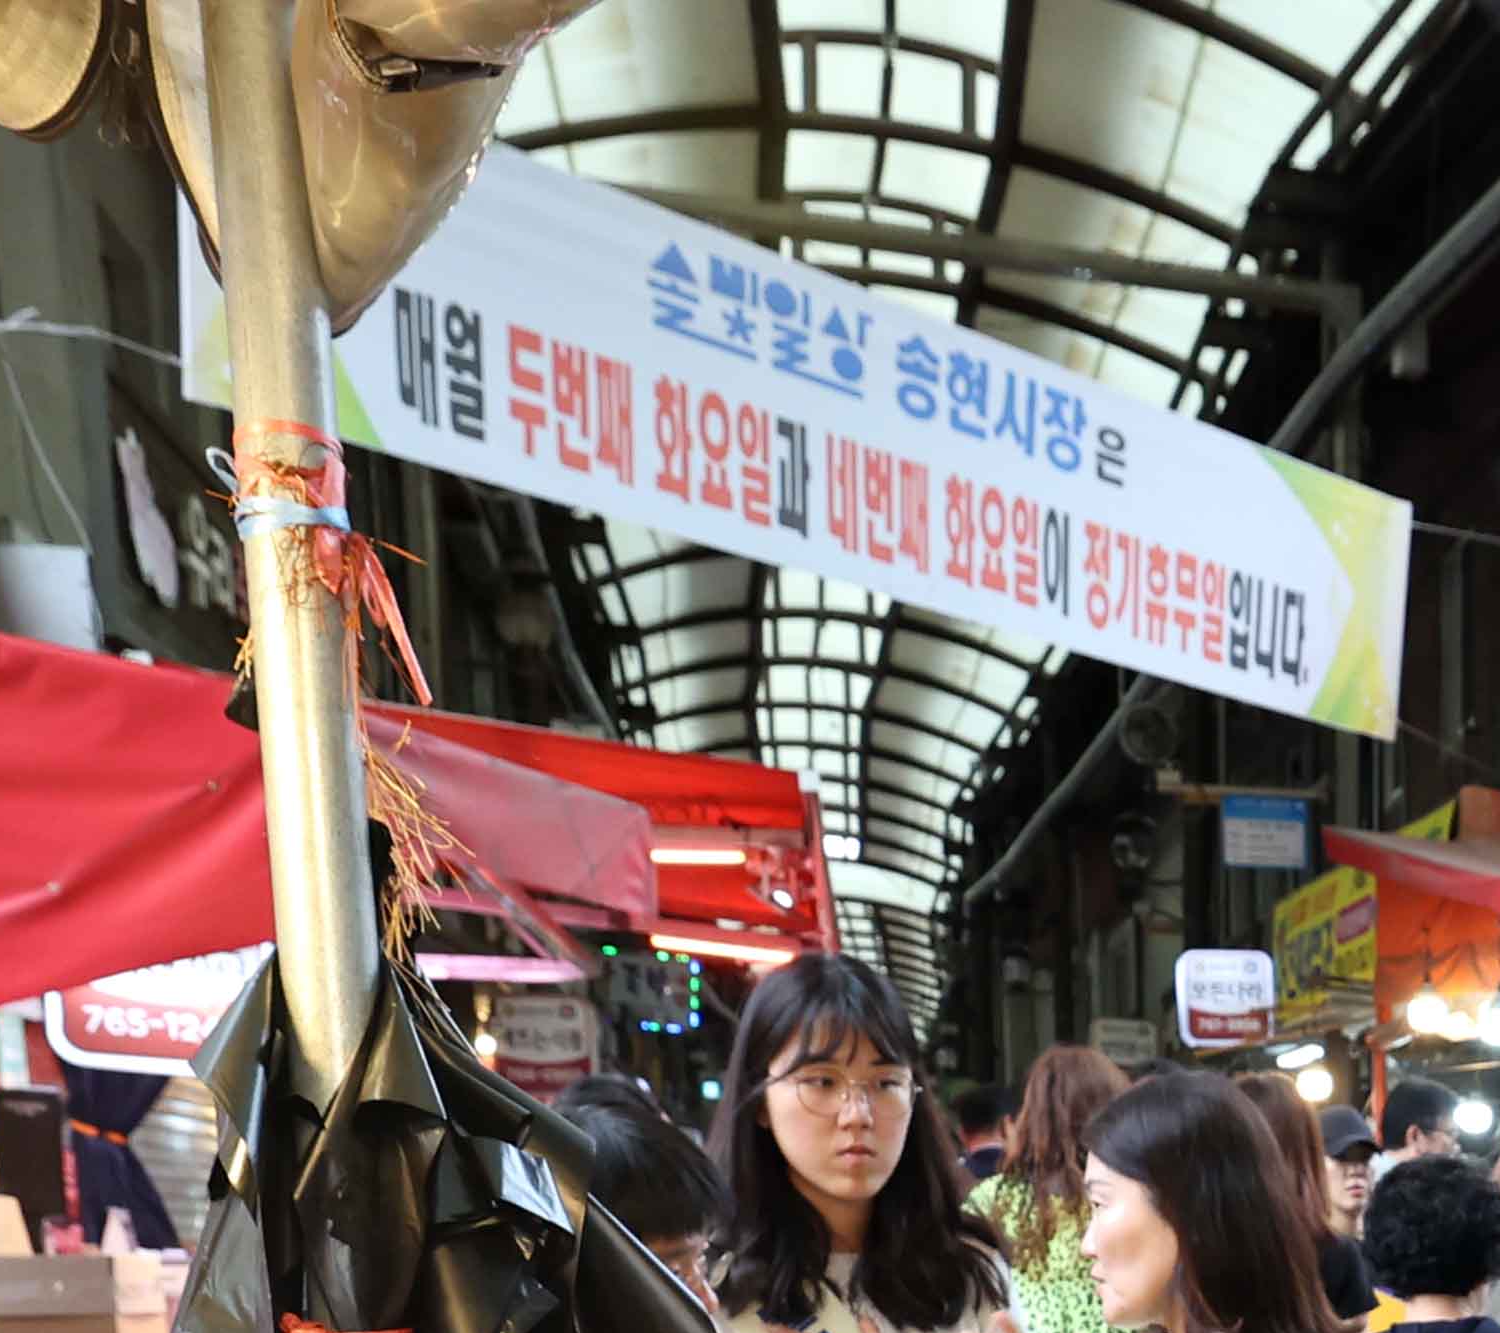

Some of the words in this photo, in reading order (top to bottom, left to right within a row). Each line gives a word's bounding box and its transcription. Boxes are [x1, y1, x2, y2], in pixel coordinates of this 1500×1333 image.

[391, 286, 488, 443] 매월
[506, 323, 636, 489] 두번째
[652, 374, 811, 542] 화요일과
[822, 434, 931, 577] 네번째
[942, 474, 1072, 617] 화요일이
[1080, 519, 1312, 688] 정기휴무일입니다.
